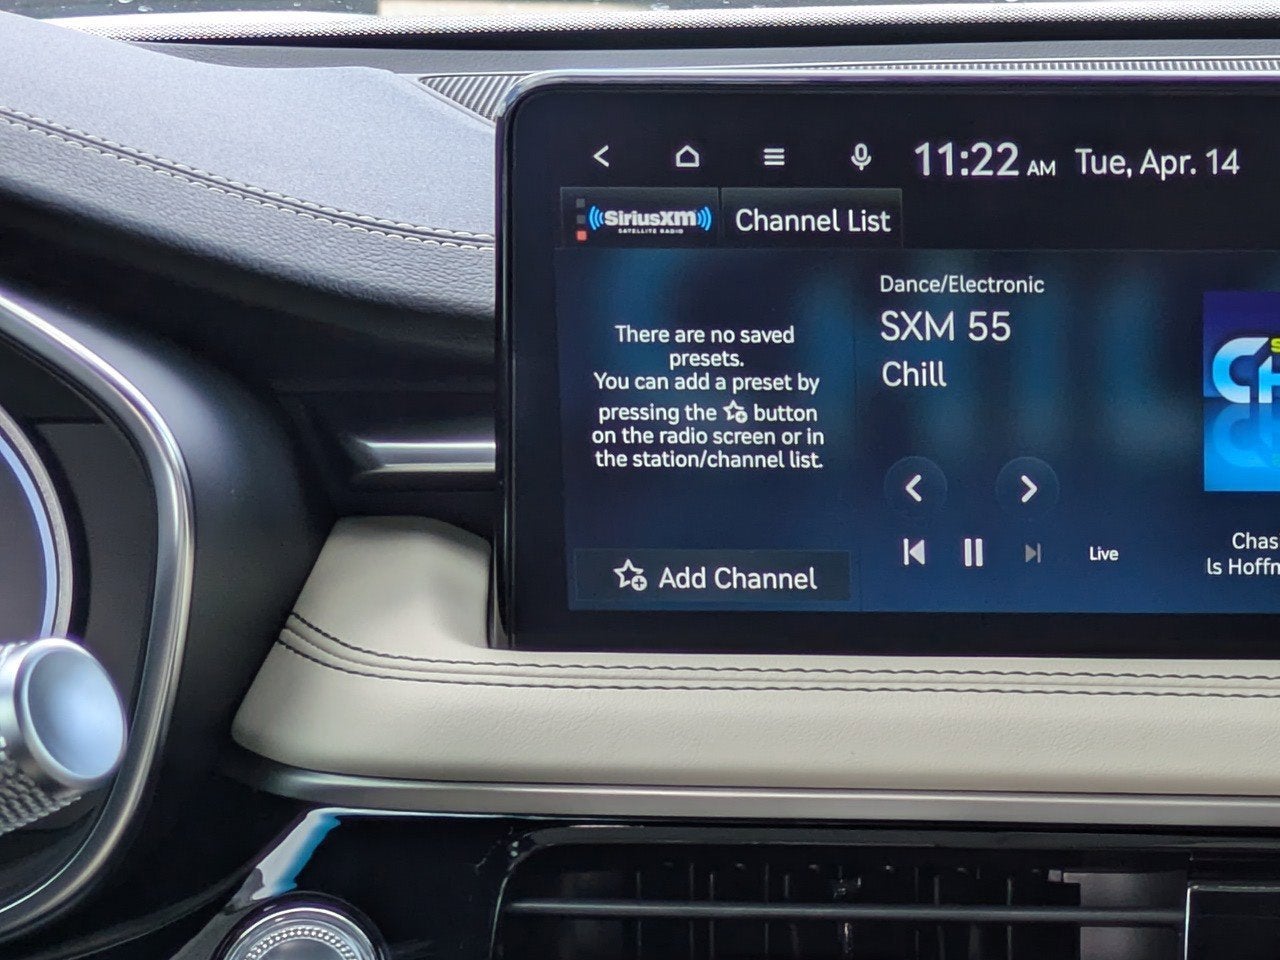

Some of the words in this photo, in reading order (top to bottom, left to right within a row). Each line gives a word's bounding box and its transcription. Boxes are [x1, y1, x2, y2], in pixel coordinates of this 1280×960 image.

[914, 141, 1020, 177] 11:22
[1026, 159, 1056, 176] AM
[1074, 148, 1132, 178] Tue,
[1139, 148, 1197, 181] Apr.
[1205, 148, 1240, 175] 14
[735, 207, 841, 232] Channel
[848, 209, 892, 233] List
[880, 274, 1045, 294] Dance/Electronic
[614, 324, 670, 343] There
[674, 329, 706, 344] are
[710, 329, 736, 344] no
[740, 325, 795, 344] saved
[880, 310, 955, 342] SXM
[968, 310, 1011, 342] 55
[669, 350, 745, 370] presets.
[593, 371, 630, 390] You
[634, 376, 669, 390] can
[674, 372, 710, 391] add
[714, 376, 727, 391] a
[732, 374, 793, 395] preset
[797, 372, 820, 395] by
[882, 360, 947, 387] Chill
[598, 402, 680, 424] pressing
[684, 402, 718, 422] the
[753, 403, 818, 422] button
[591, 429, 617, 444] on
[621, 426, 655, 444] the
[659, 427, 708, 445] radio
[712, 430, 776, 445] screen
[781, 430, 803, 445] or
[806, 428, 825, 445] in
[594, 449, 628, 468] the
[632, 449, 785, 468] station/channel
[789, 450, 824, 469] list.
[1089, 546, 1119, 561] Live
[658, 566, 707, 590] Add
[714, 566, 818, 590] Channel
